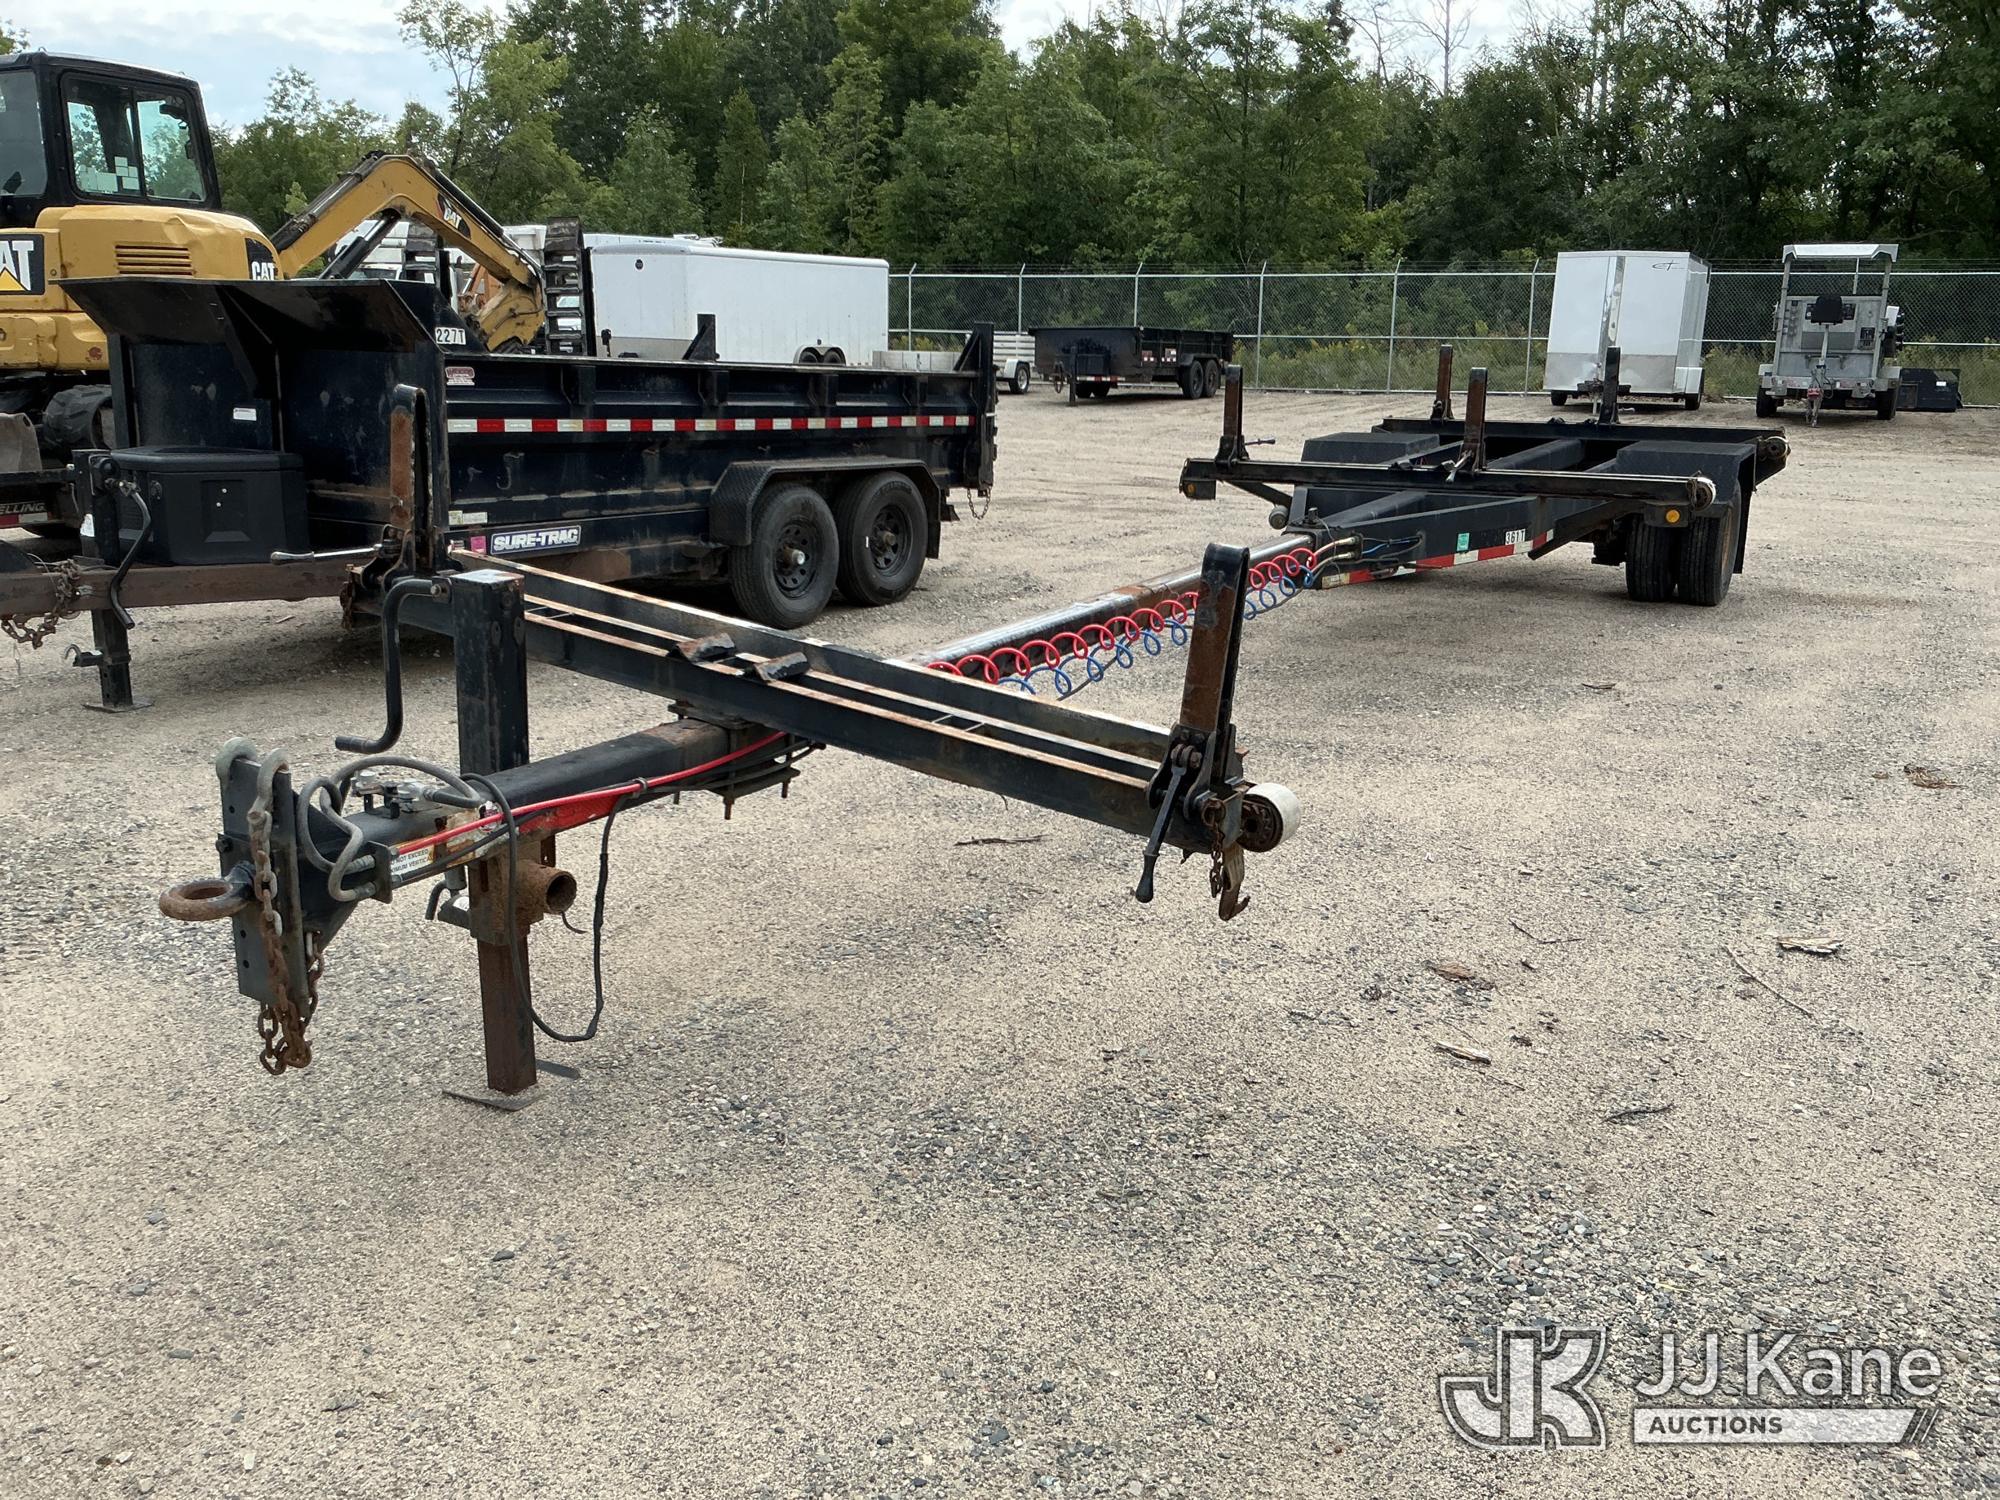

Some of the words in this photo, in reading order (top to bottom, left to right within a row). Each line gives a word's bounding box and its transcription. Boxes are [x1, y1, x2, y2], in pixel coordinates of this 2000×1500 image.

[444, 207, 462, 229] CAT
[0, 240, 35, 291] AT
[251, 261, 275, 280] CAT
[436, 329, 464, 344] 227T
[0, 502, 46, 515] ELLING
[493, 528, 579, 551] SURE-TRAC
[1506, 531, 1525, 544] 361T
